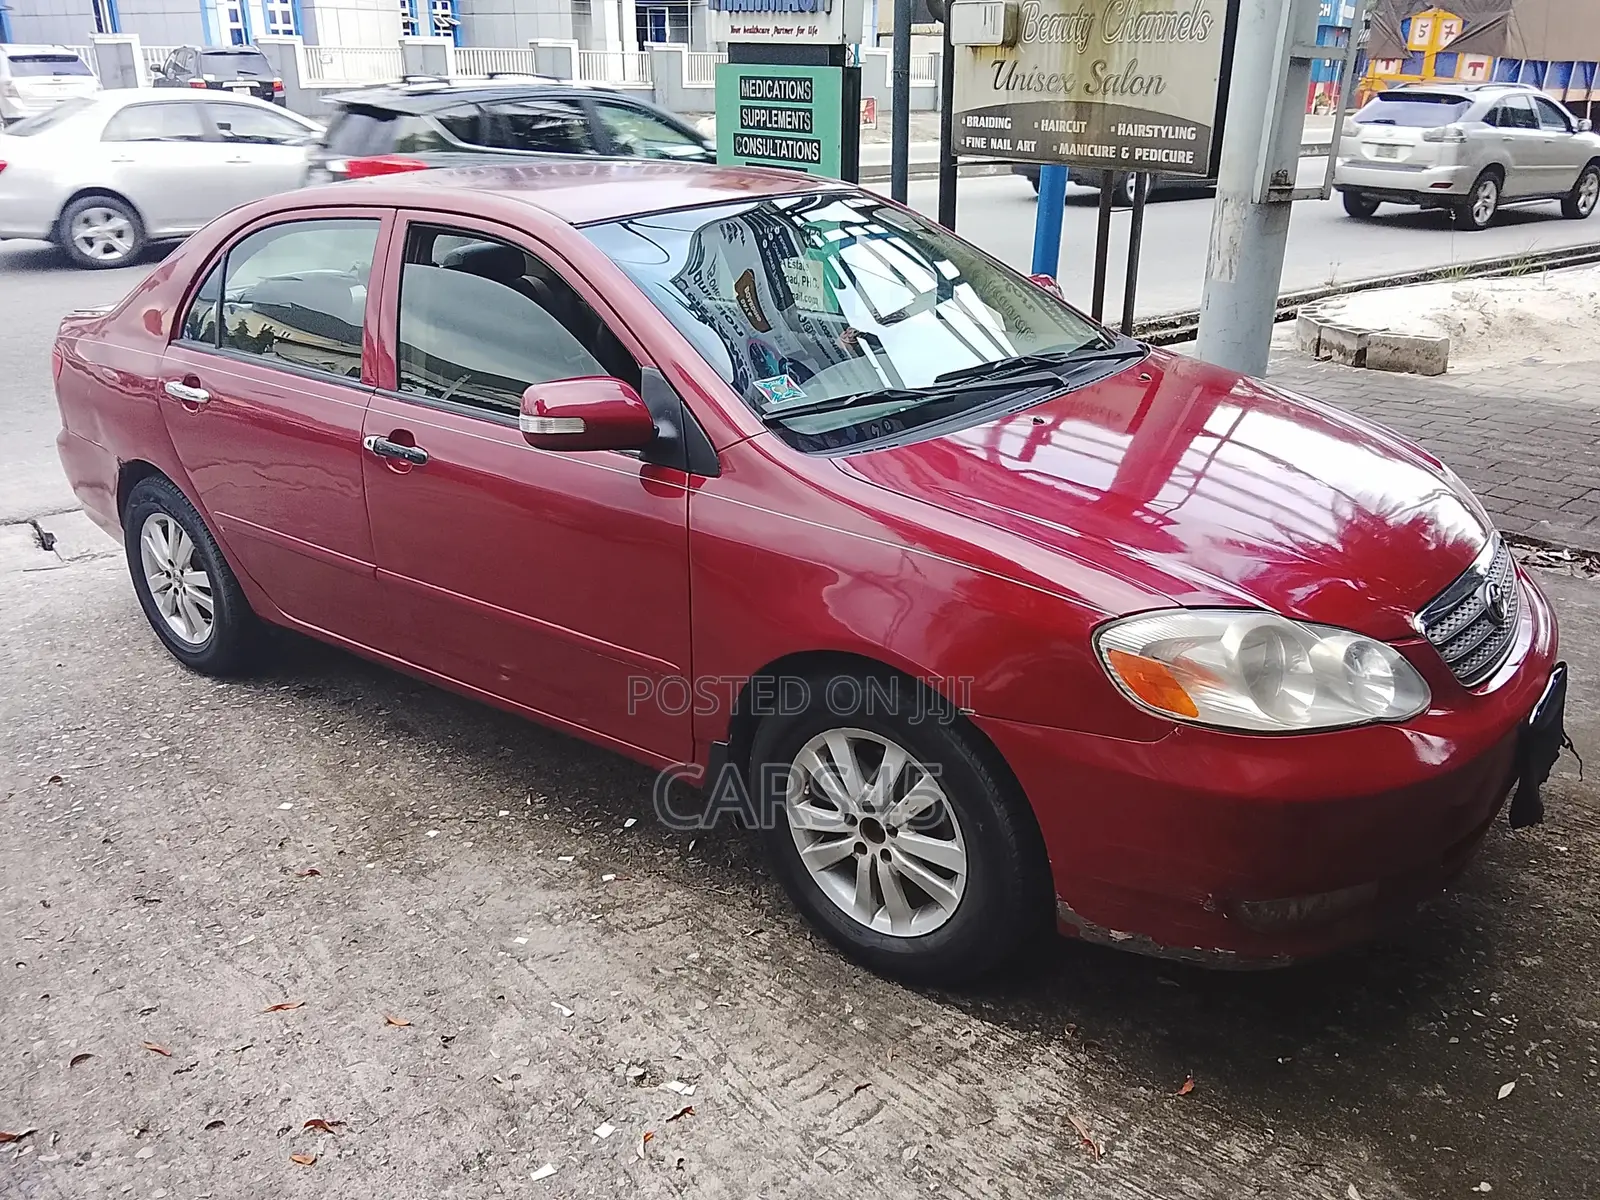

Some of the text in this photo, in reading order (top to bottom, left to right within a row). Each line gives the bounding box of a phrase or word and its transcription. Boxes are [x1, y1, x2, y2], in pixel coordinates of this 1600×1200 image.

[730, 25, 741, 34] Your
[743, 25, 770, 34] healthcare
[796, 26, 805, 37] for
[808, 25, 818, 35] life
[1021, 0, 1214, 54] Beauty Channels
[991, 58, 1167, 96] Unisex Salon
[741, 79, 812, 100] MEDICATIONS
[742, 108, 811, 130] SUPPLEMENTS
[966, 116, 1196, 140] BRAIDING HAIRCUT HAIRSTYLING
[735, 136, 819, 161] CONSULTATIONS
[966, 136, 1194, 164] FINE NAIL ART MANICURE & PEDICURE
